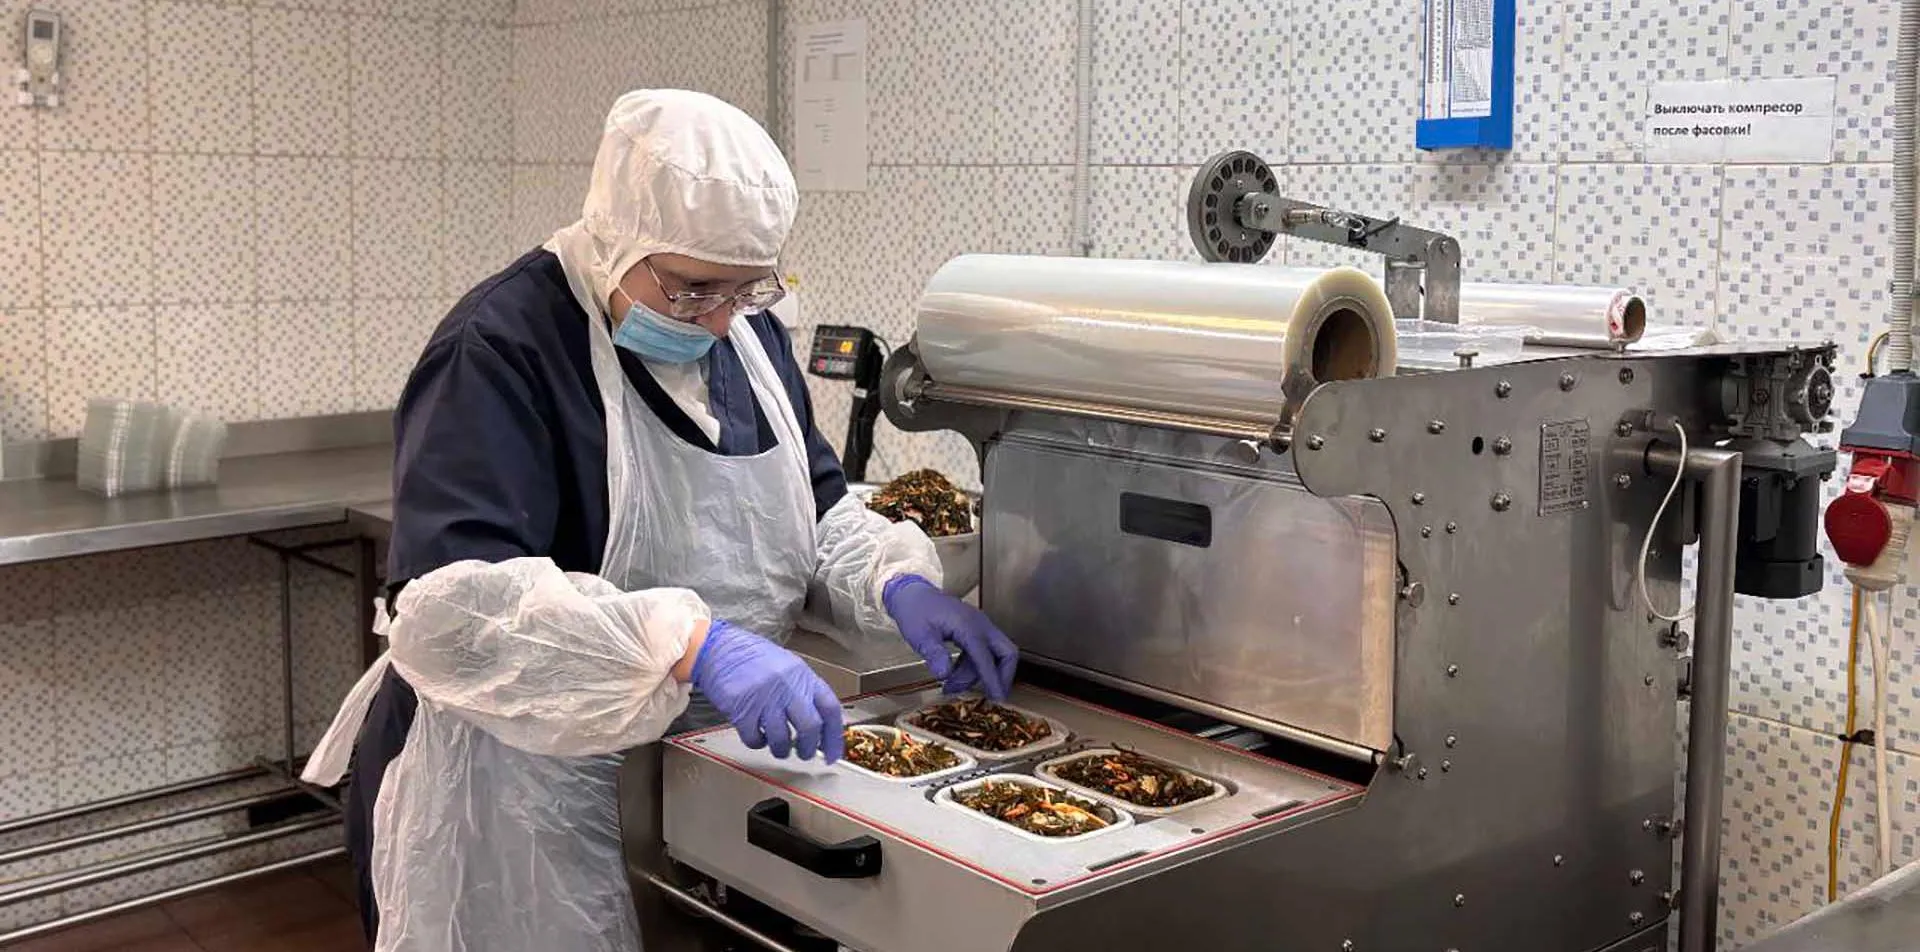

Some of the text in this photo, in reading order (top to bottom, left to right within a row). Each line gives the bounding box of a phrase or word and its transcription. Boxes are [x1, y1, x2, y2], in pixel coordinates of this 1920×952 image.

[1653, 103, 1803, 116] Выключать компресор
[1653, 124, 1751, 138] после фасовки!
